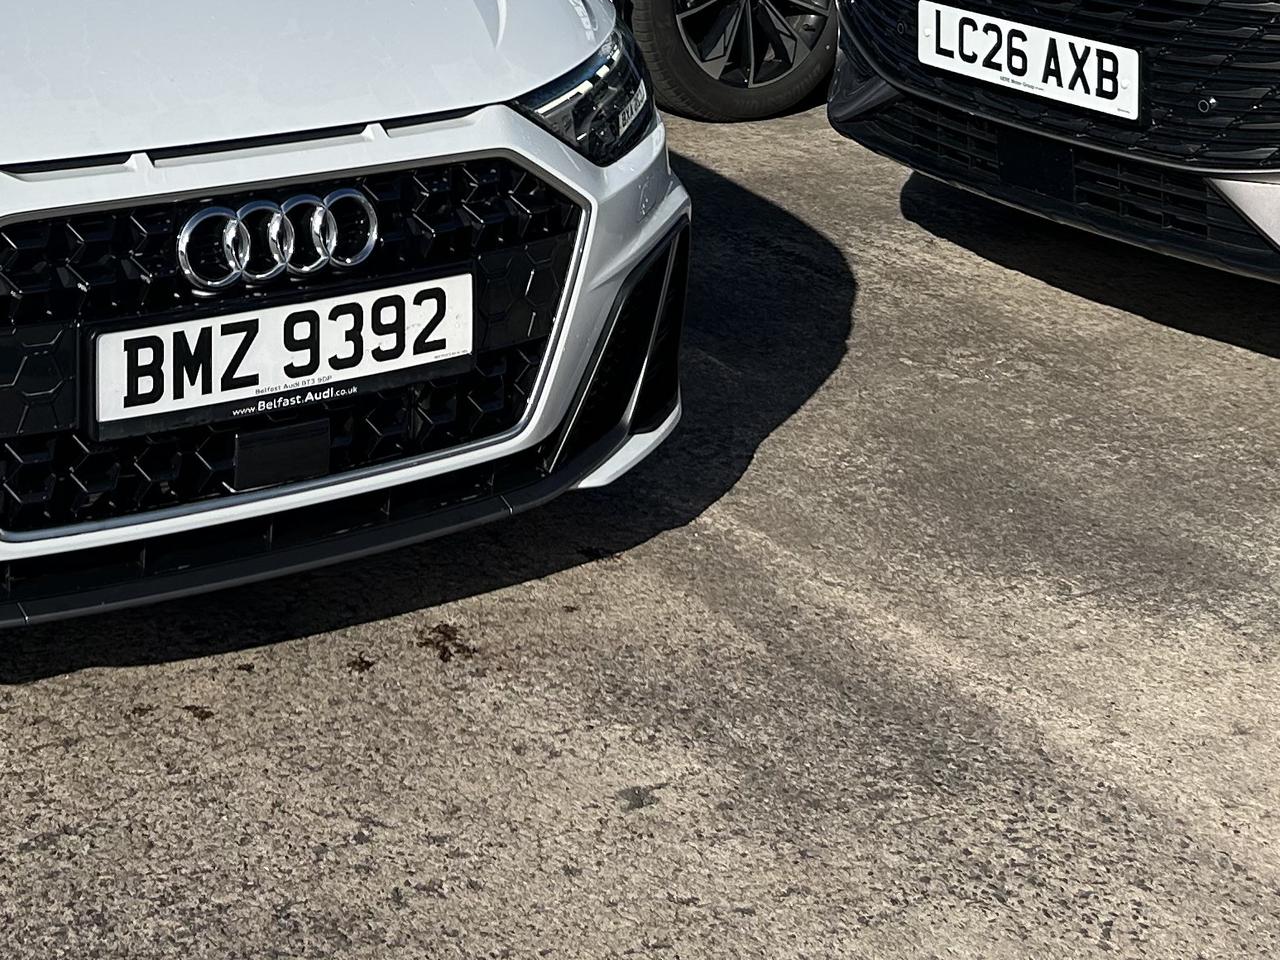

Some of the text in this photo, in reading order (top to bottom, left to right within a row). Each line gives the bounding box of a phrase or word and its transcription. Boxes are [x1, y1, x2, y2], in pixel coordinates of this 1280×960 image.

[935, 9, 1119, 101] LC26 AXB
[123, 286, 447, 409] BMZ 9392
